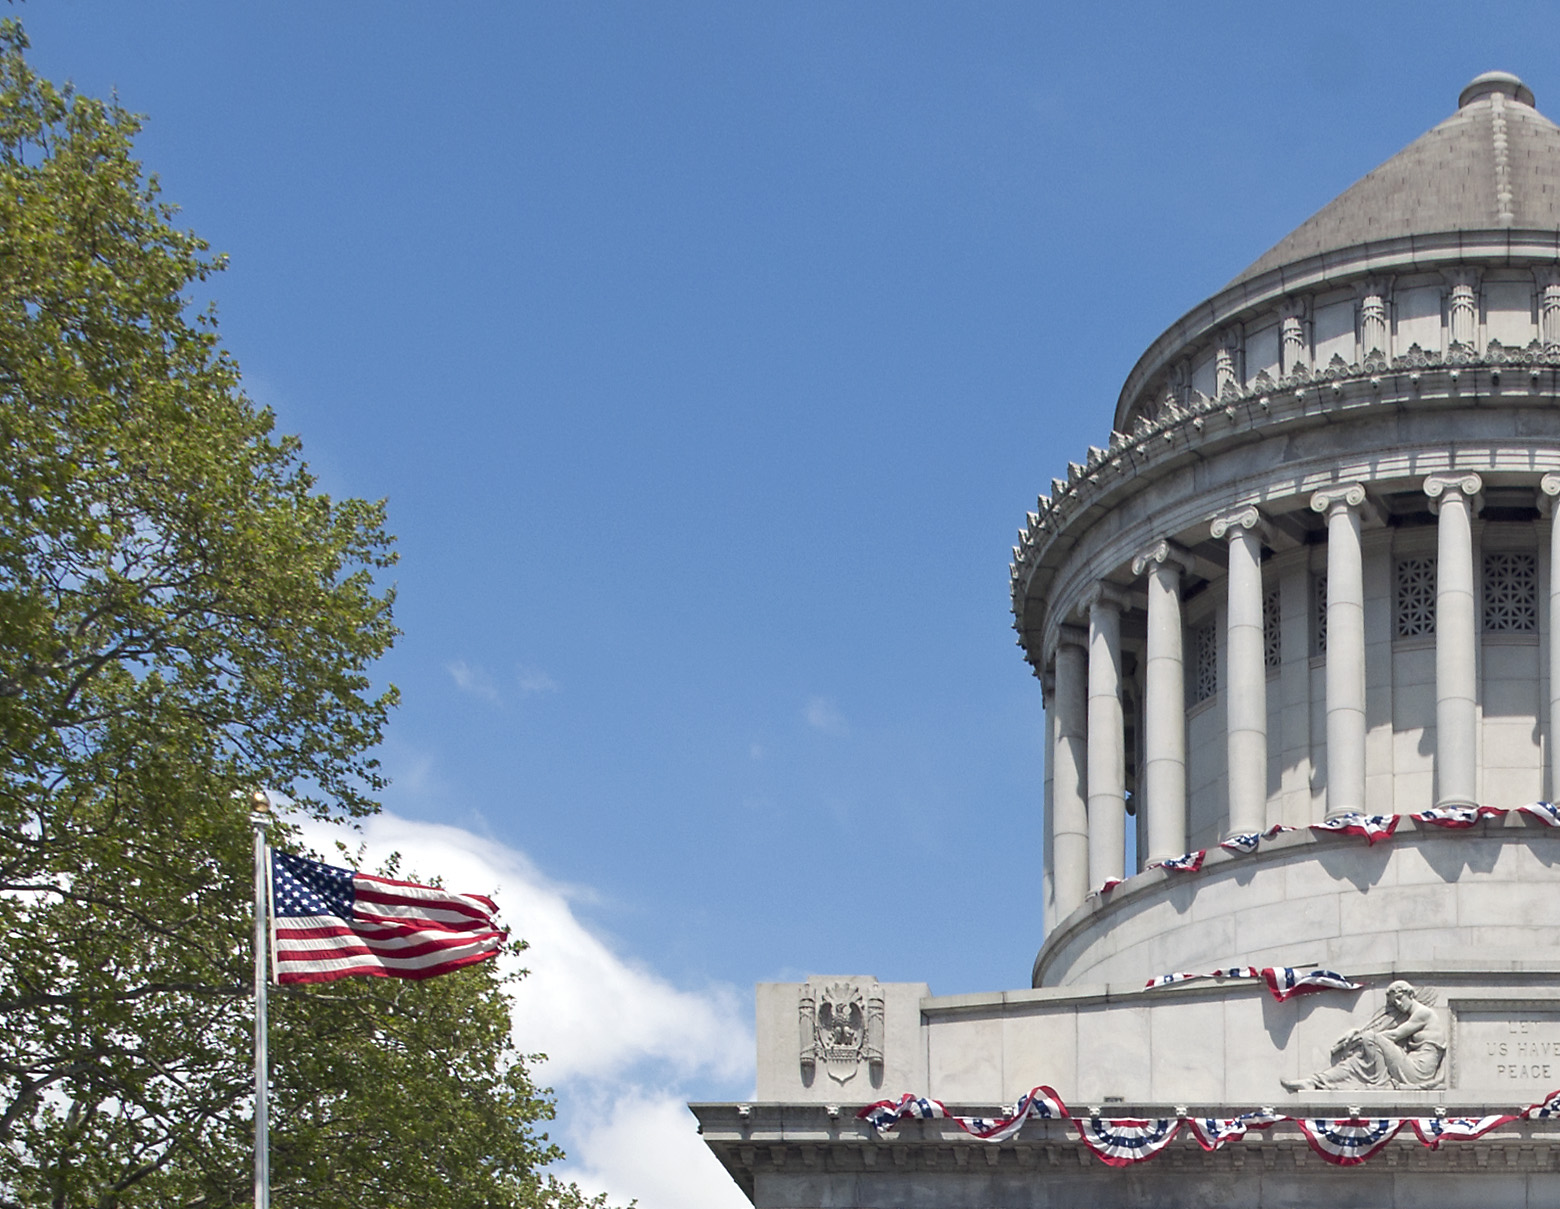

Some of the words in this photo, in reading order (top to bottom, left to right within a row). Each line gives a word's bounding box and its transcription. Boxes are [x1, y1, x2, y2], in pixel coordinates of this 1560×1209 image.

[1508, 1020, 1541, 1034] LET
[1486, 1042, 1508, 1056] US
[1497, 1064, 1551, 1079] PEACE
